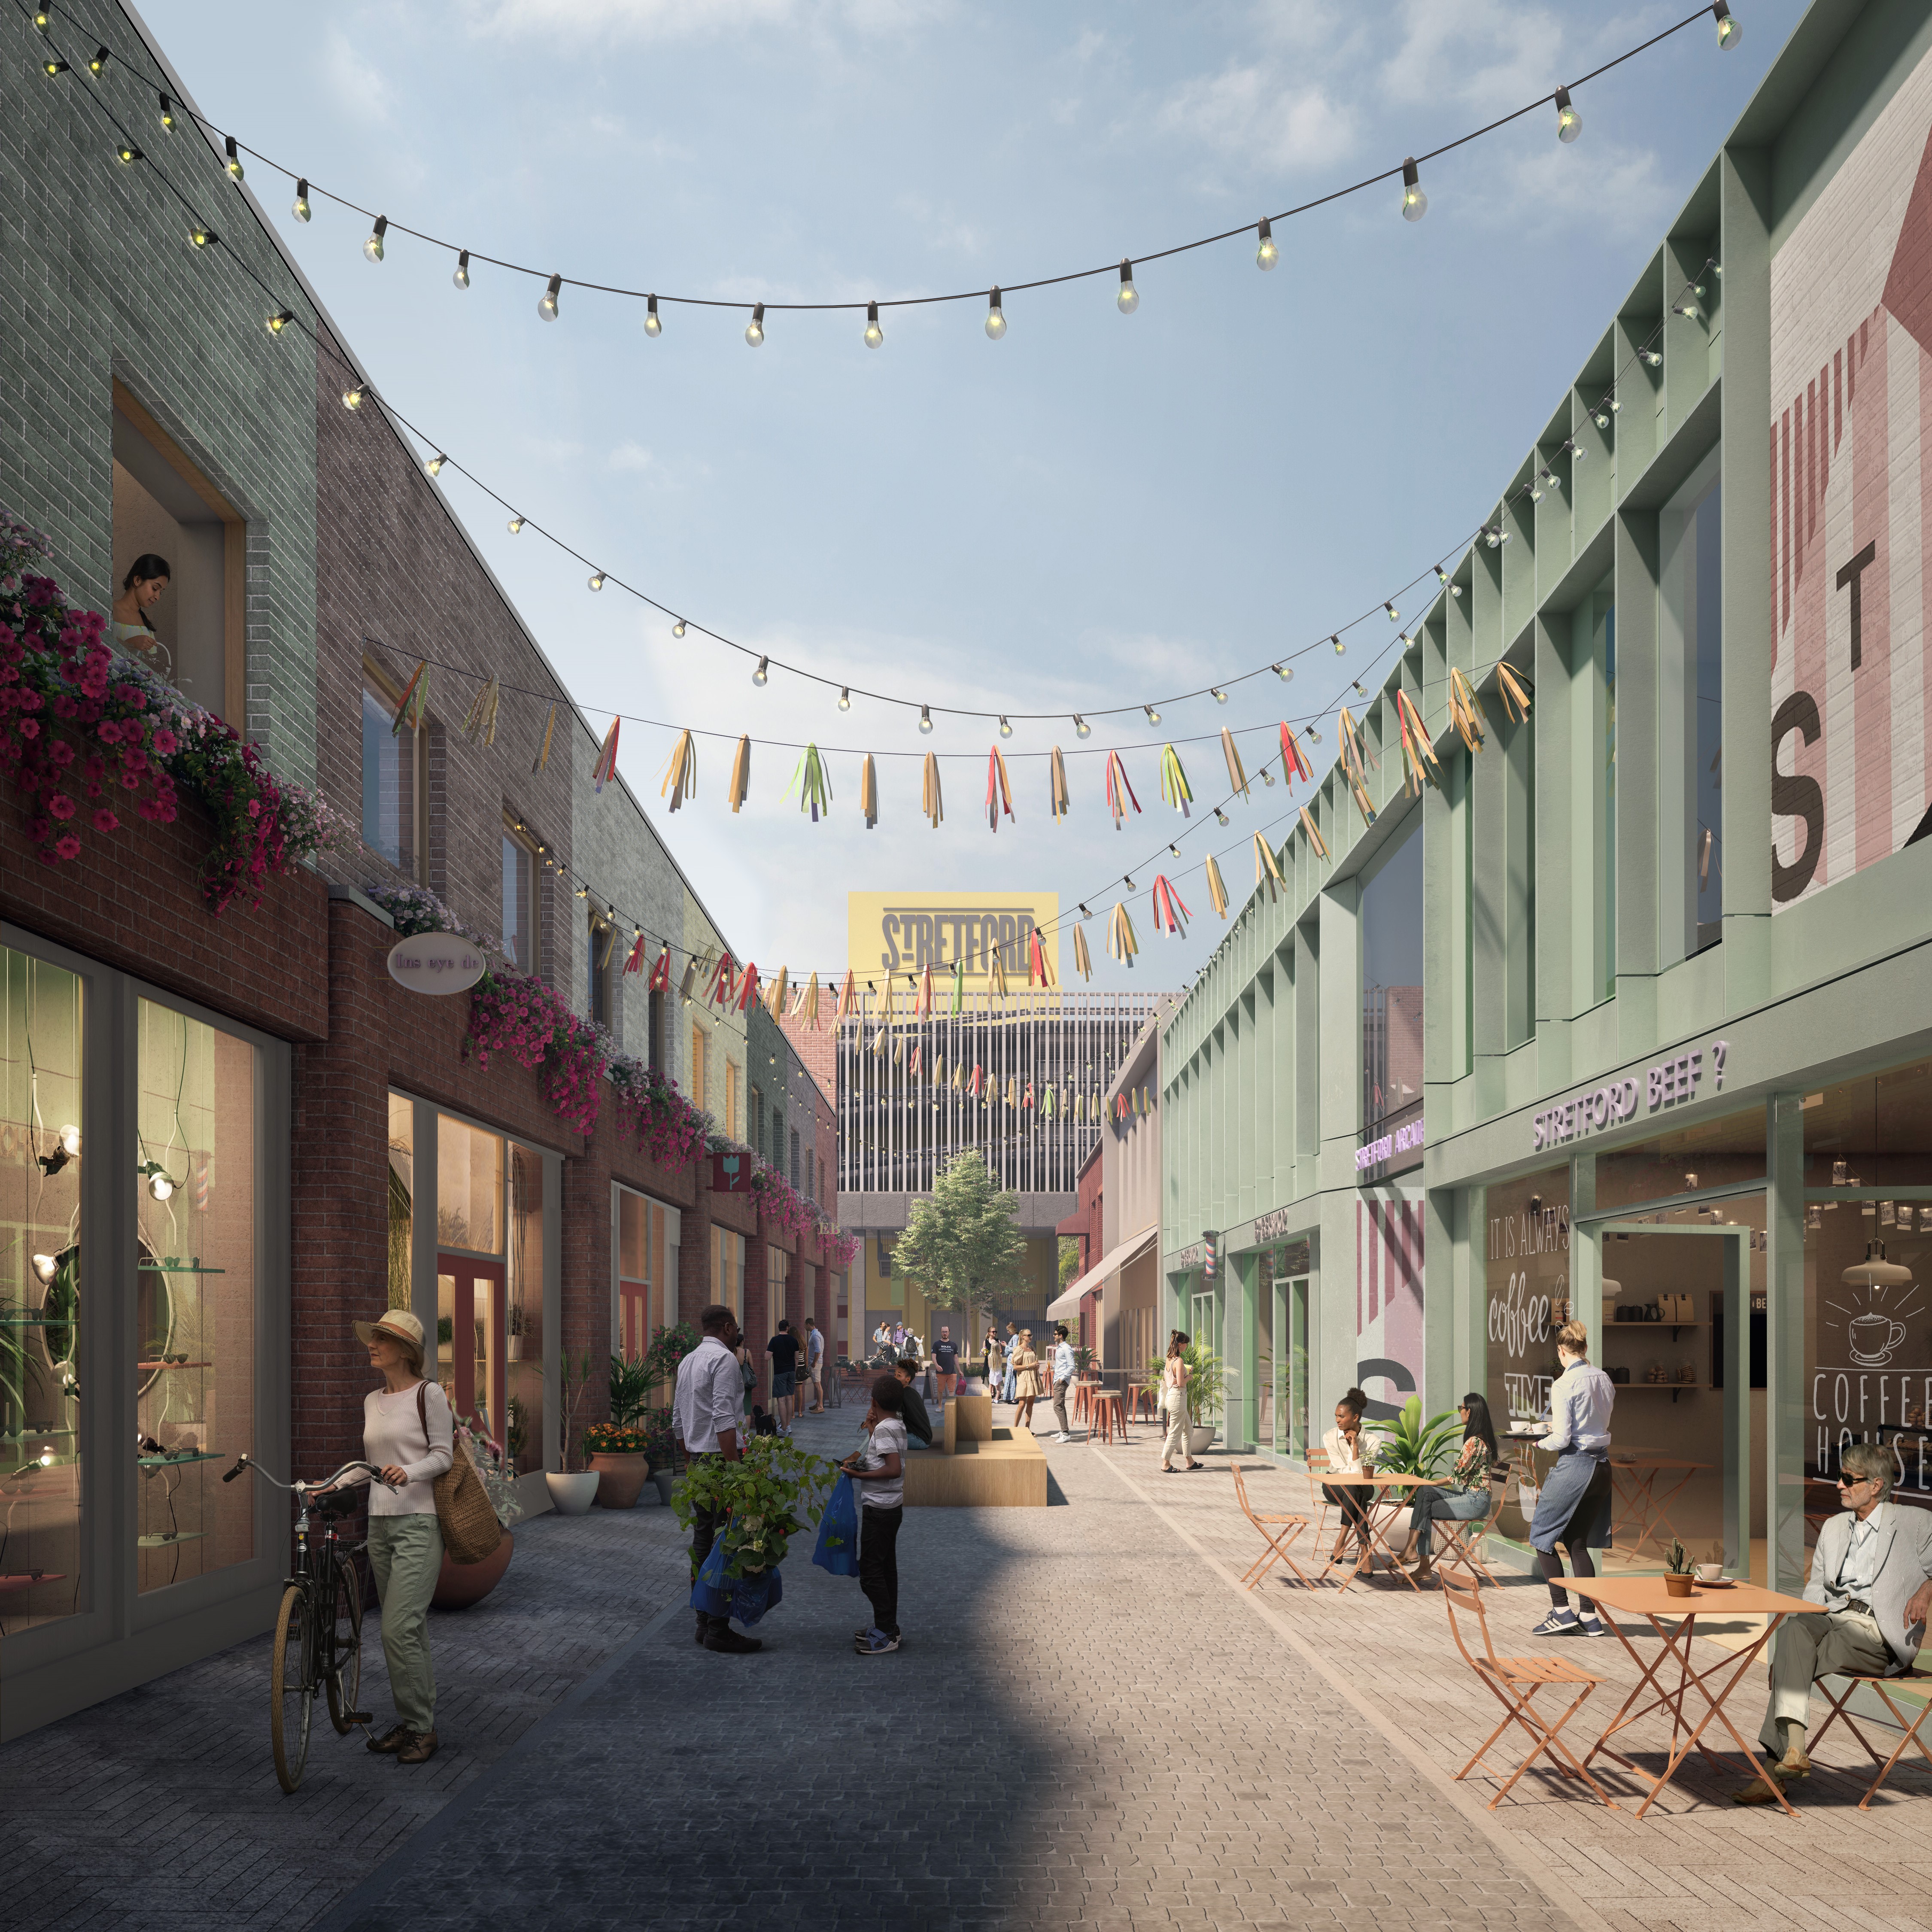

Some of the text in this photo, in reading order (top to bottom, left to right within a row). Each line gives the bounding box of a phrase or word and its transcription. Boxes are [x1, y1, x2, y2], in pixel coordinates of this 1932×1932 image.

[1836, 539, 1875, 673] T
[1771, 691, 1824, 903] S
[396, 954, 483, 972] Ins eye de
[882, 914, 1035, 971] STRETFORD
[1533, 1077, 1639, 1147] STRETFORD
[1646, 1049, 1703, 1107] BEEF
[1355, 1134, 1392, 1172] STRETFORD
[818, 1222, 841, 1234] EB
[1491, 1205, 1569, 1260] IT IS ALWAYS
[1488, 1271, 1549, 1358] coffee
[1756, 1298, 1767, 1309] BE
[1505, 1373, 1555, 1422] TIME
[1814, 1374, 1932, 1429] COFFEE
[1818, 1426, 1930, 1490] HOSE
